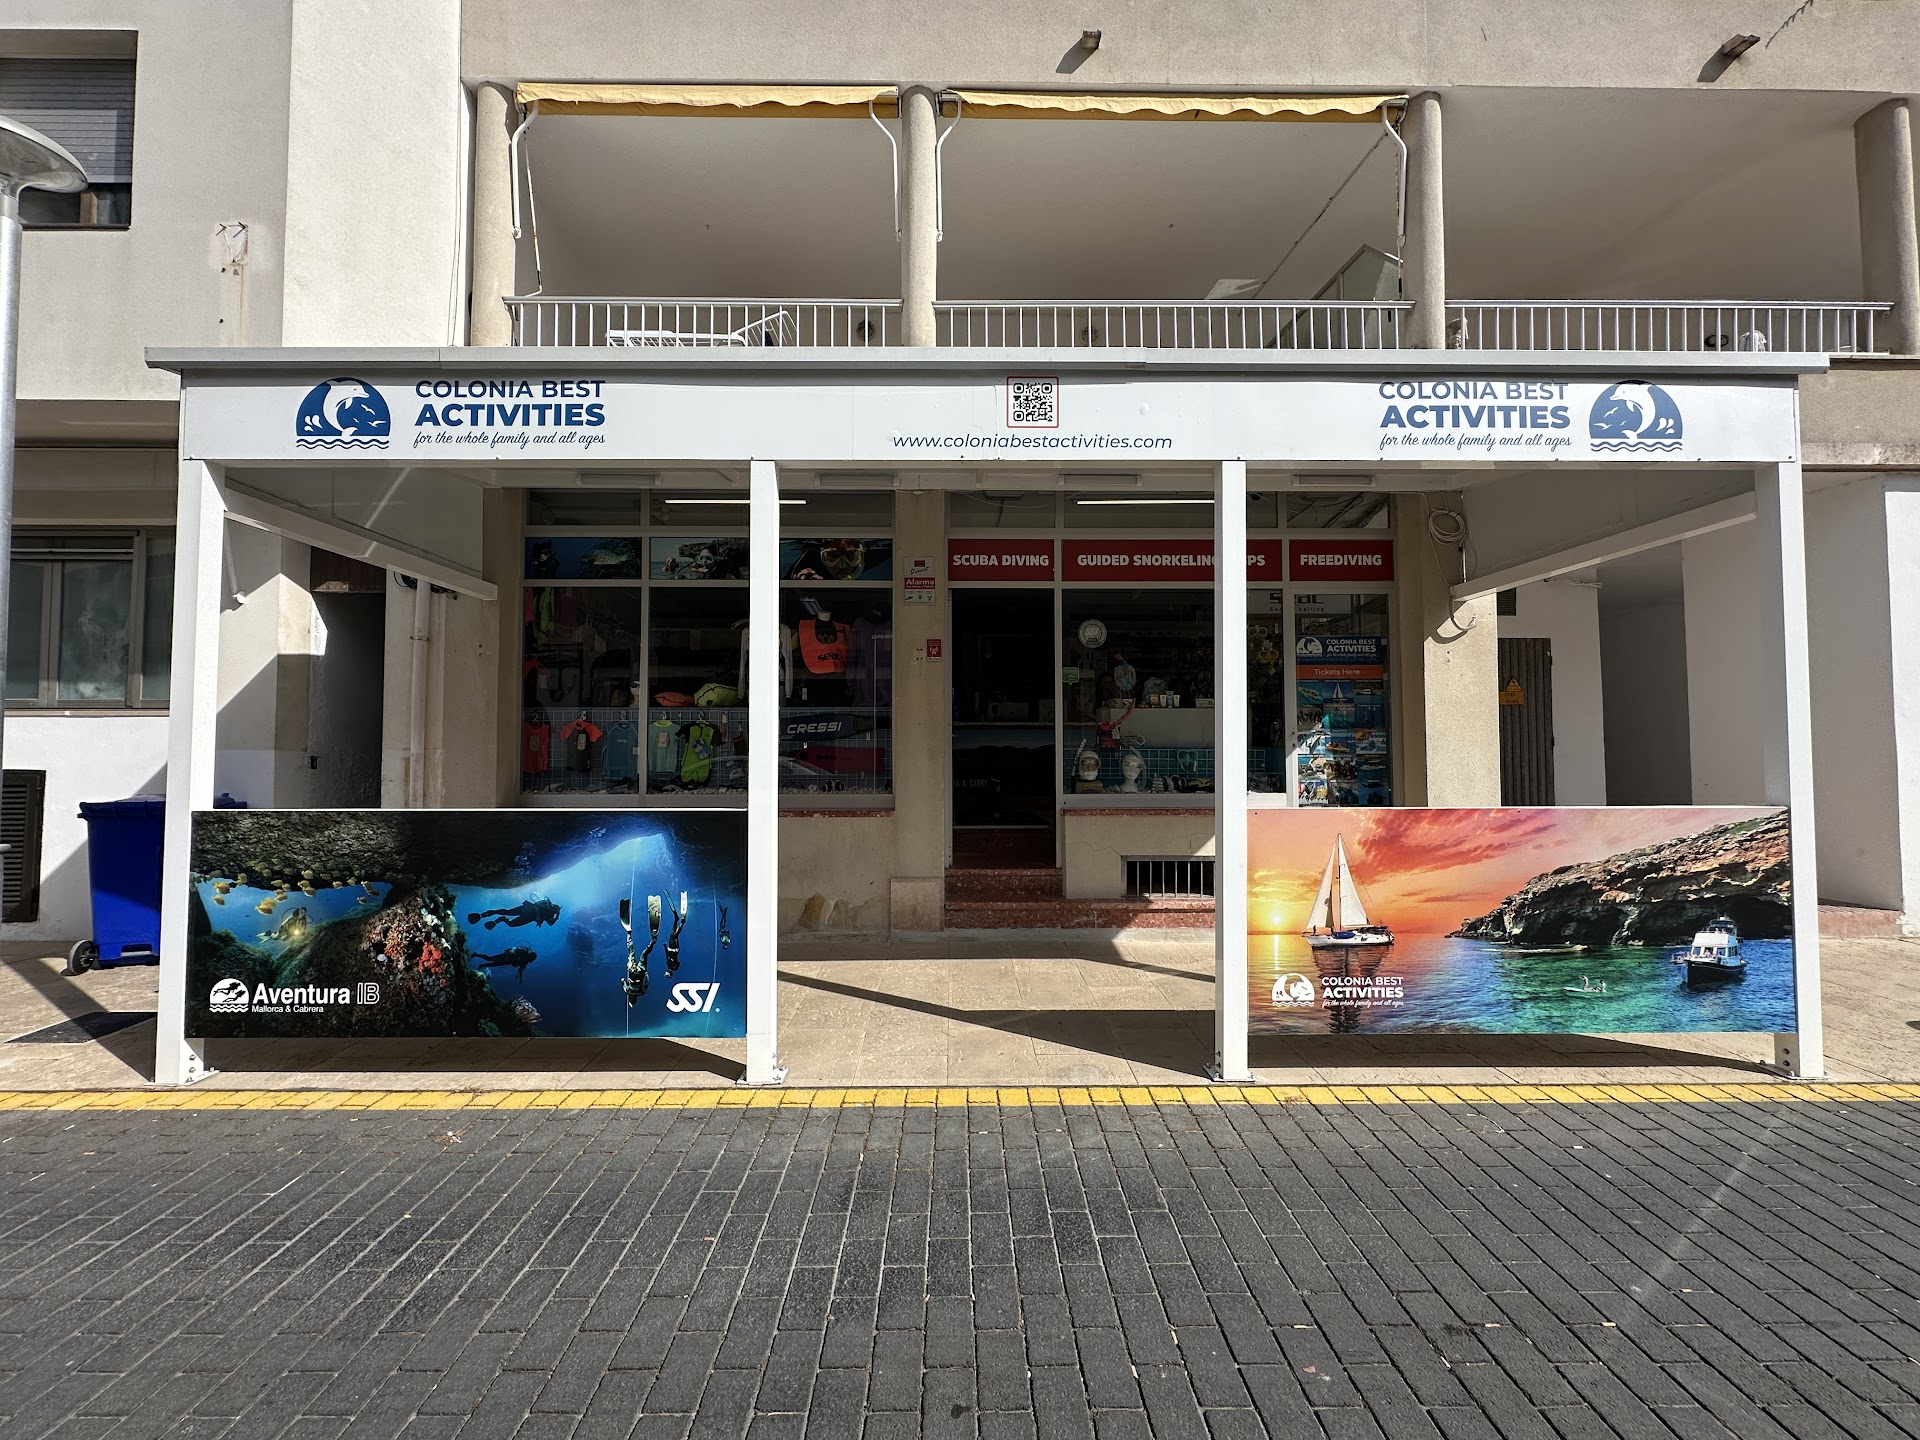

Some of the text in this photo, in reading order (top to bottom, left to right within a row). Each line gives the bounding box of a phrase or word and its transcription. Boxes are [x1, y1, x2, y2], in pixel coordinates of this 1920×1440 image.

[415, 380, 606, 398] COLONIA BEST
[1379, 381, 1569, 400] COLONIA BEST
[414, 403, 606, 427] ACTIVITIES
[1379, 404, 1571, 429] ACTIVITIES
[413, 430, 606, 450] for the whole family and all ages
[892, 433, 1173, 449] www.coloniabestactivities.com
[1379, 432, 1573, 453] for the whole family and all ages
[952, 554, 1050, 567] SCUBA DIVING
[1077, 554, 1130, 567] GUIDED
[1300, 554, 1383, 567] FREEDIVING
[906, 578, 935, 586] Alarma
[1326, 645, 1377, 653] ACTIVITIES
[1313, 668, 1361, 676] Tickets Here
[787, 721, 842, 735] CRESSI
[1321, 976, 1404, 986] COLONIA BEST
[252, 982, 380, 1004] Aventura IB
[665, 982, 721, 1013] SSI
[1322, 987, 1404, 999] ACTIVITIES
[252, 1005, 324, 1013] Mallorca & Cabrera
